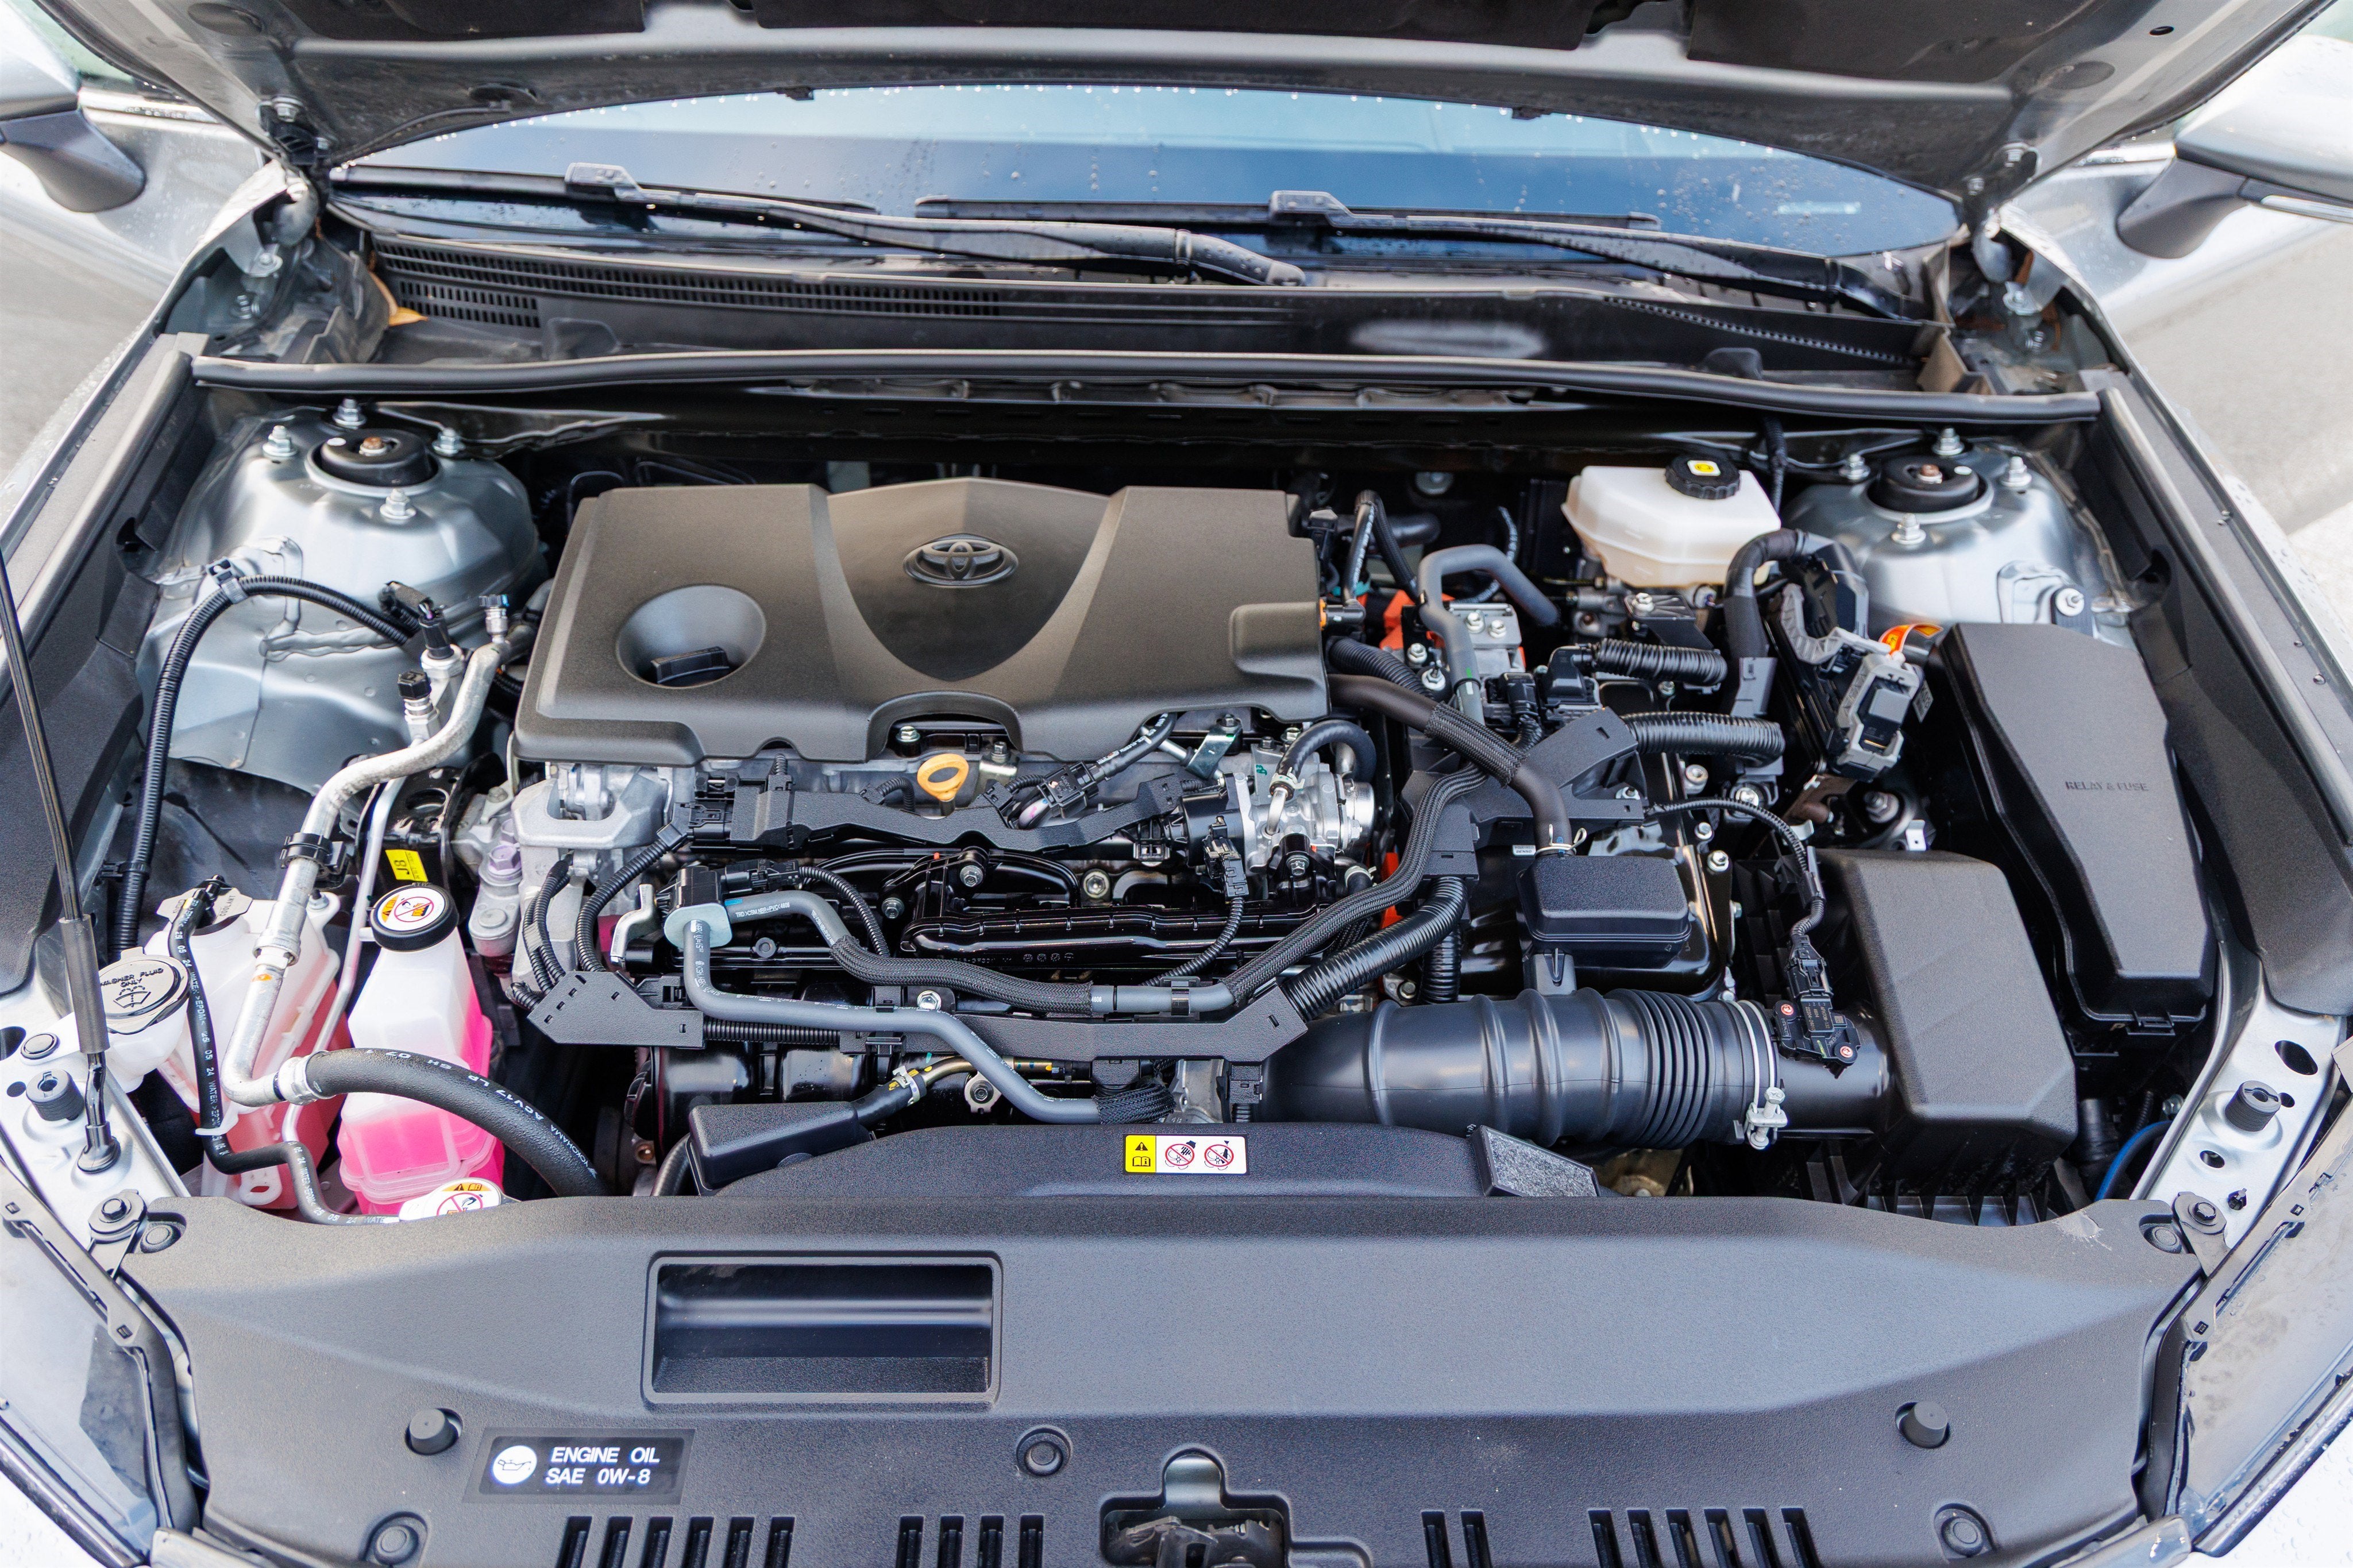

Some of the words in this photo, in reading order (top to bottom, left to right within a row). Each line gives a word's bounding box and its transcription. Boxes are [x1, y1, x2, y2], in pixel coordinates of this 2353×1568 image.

[2065, 781, 2103, 790] RELAY
[2107, 782, 2115, 791] &
[2117, 782, 2149, 791] FUSE
[394, 860, 410, 875] J8
[219, 894, 236, 917] COOLANT
[177, 945, 187, 953] 05
[182, 959, 192, 967] 24
[140, 968, 164, 977] FLUID
[120, 978, 142, 987] ONLY
[190, 971, 200, 994] WATER
[385, 1051, 411, 1059] 07
[206, 1067, 214, 1076] 24
[468, 1074, 491, 1087] LP
[209, 1080, 218, 1104] WATER
[496, 1089, 545, 1120] ACV17
[550, 1124, 589, 1167] YOKOHAMA
[299, 1167, 311, 1187] WATER
[550, 1446, 620, 1463] ENGINE
[630, 1446, 661, 1463] OIL
[545, 1467, 587, 1484] SAE
[597, 1468, 651, 1484] 0W-8
